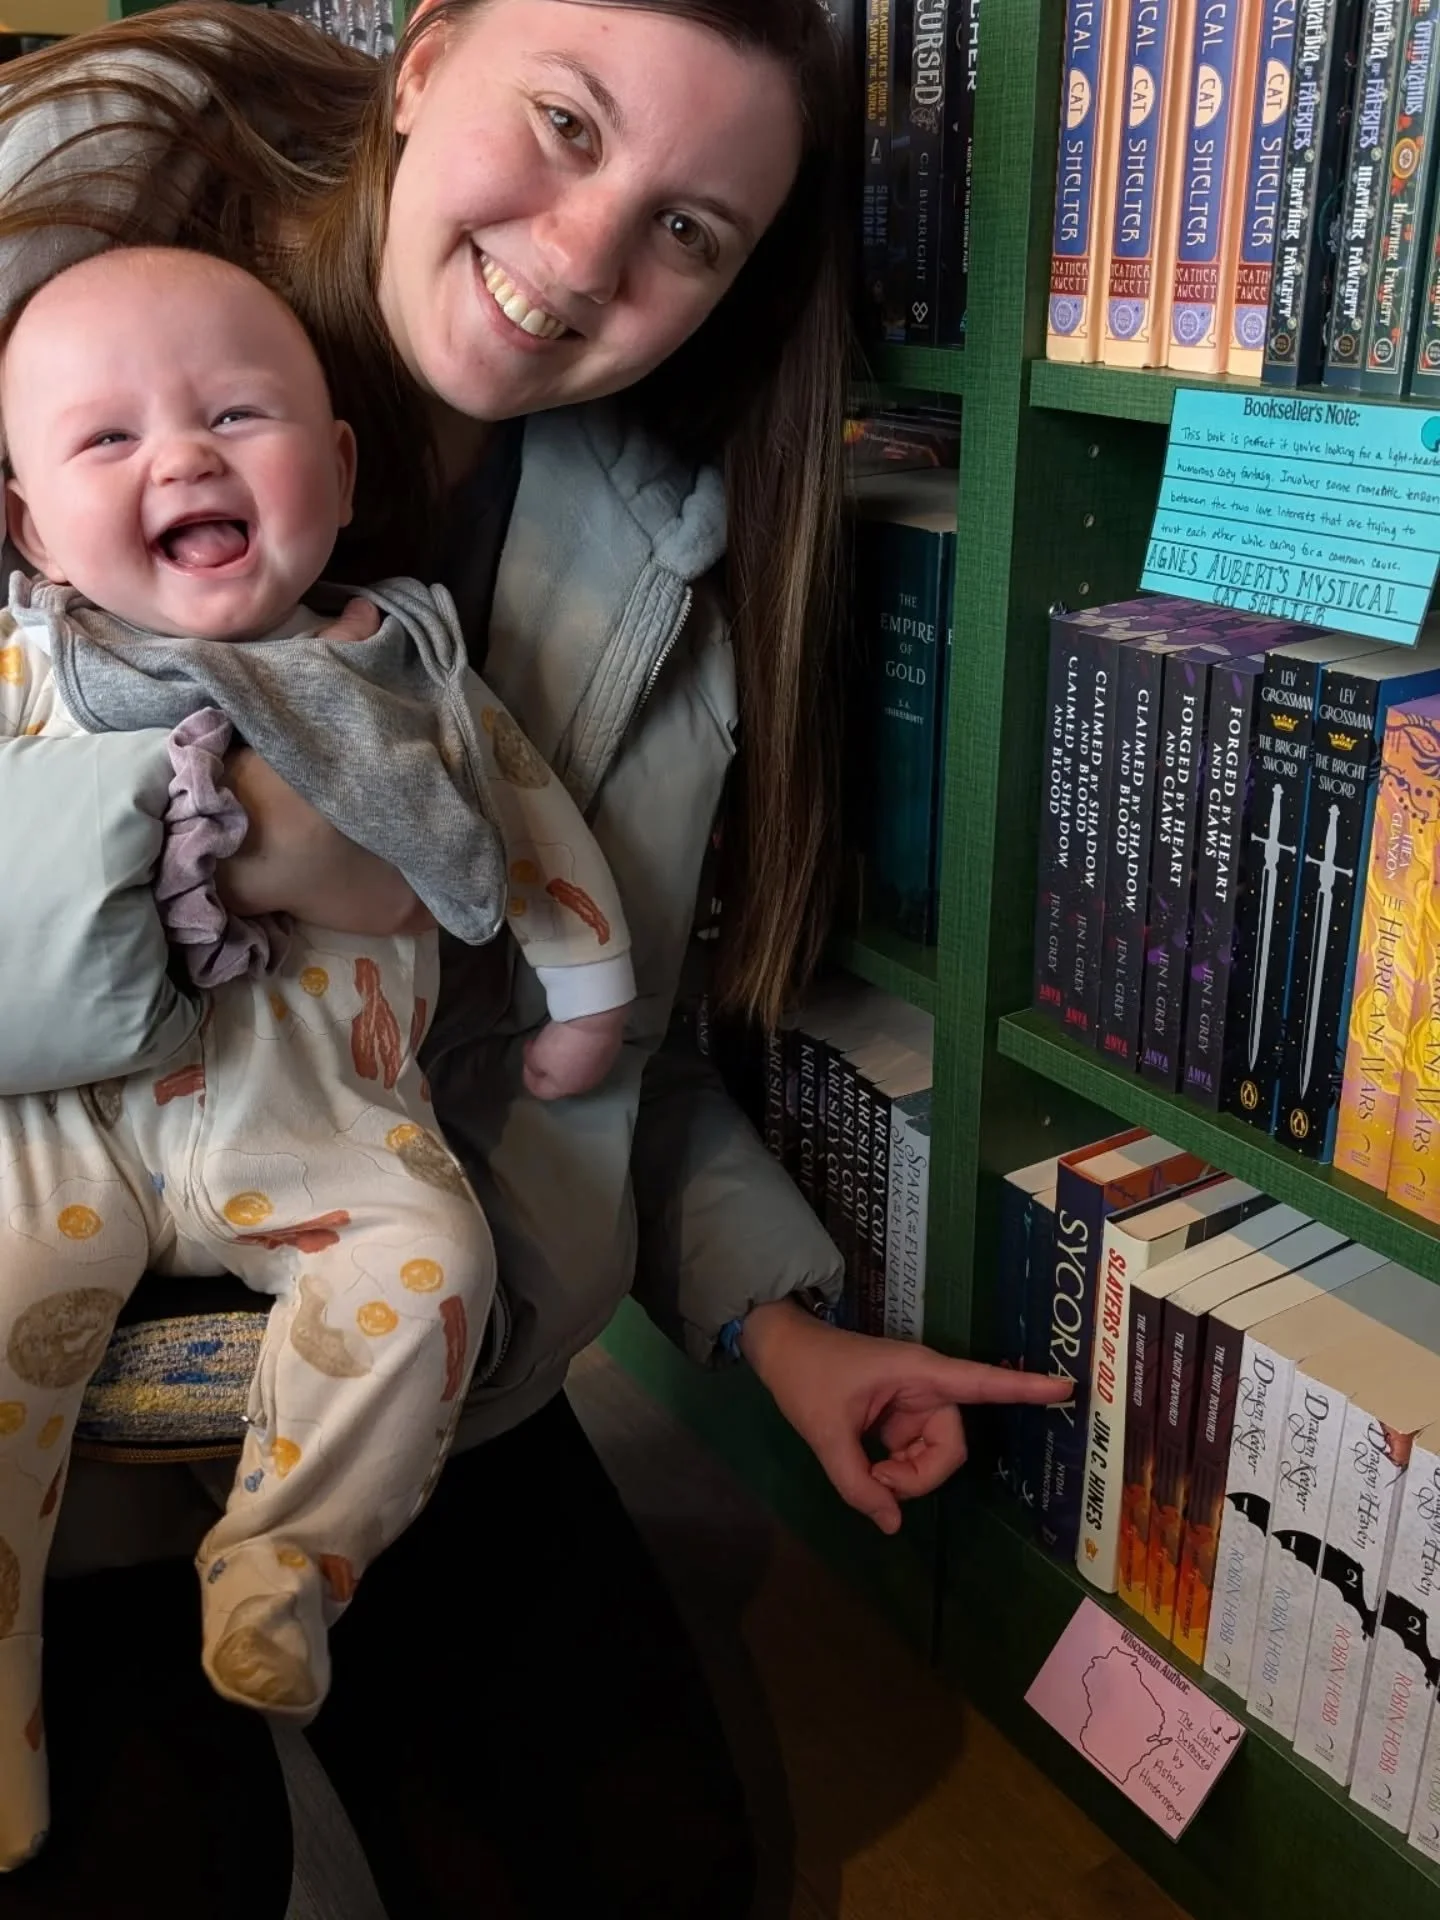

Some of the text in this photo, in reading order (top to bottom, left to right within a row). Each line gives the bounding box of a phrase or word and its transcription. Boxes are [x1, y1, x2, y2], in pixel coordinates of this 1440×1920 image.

[913, 0, 946, 105] CURSED
[1070, 82, 1085, 115] CAT
[1198, 78, 1216, 113] CAT
[1294, 82, 1317, 150] FAERIES
[1360, 78, 1385, 149] FAERIES
[1121, 78, 1148, 243] CAT SHELTER
[1251, 73, 1284, 247] CAT SHELTER
[1061, 139, 1083, 241] SHELTER
[1186, 139, 1214, 246] SHELTER
[1286, 167, 1306, 240] HEATHER
[1351, 166, 1374, 240] HEATHER
[1279, 246, 1298, 318] FAWCETT
[1344, 246, 1364, 318] FAWCETT
[1244, 398, 1360, 428] Bookseller's Note:
[1182, 427, 1200, 440] This
[1207, 429, 1224, 442] book
[1230, 433, 1238, 444] is
[1244, 436, 1275, 448] perfect
[1294, 440, 1320, 455] you're
[1325, 442, 1355, 464] looking
[1360, 446, 1372, 459] for
[1217, 467, 1236, 484] cozy
[1280, 469, 1320, 489] Involves
[1326, 480, 1350, 493] some
[1170, 491, 1206, 506] between
[1211, 492, 1227, 510] the
[1231, 498, 1250, 512] two
[1256, 504, 1272, 518] love
[1278, 505, 1316, 522] interests
[1320, 509, 1342, 526] that
[1366, 517, 1397, 541] trying
[1402, 524, 1416, 534] to
[1161, 524, 1182, 536] trust
[1186, 525, 1207, 538] each
[1212, 527, 1236, 542] other
[1241, 533, 1266, 548] while
[1269, 540, 1296, 560] caring
[1328, 551, 1365, 566] common
[900, 592, 918, 608] THE
[1147, 544, 1399, 616] AGNES AUBERT'S MYSTICAL
[1212, 585, 1327, 626] CAT SHELTER
[880, 612, 936, 644] EMPIRE
[900, 642, 913, 656] OF
[886, 660, 926, 686] GOLD
[1261, 687, 1314, 712] GROSSMAN
[1281, 670, 1298, 686] LEV
[1340, 688, 1356, 704] LEV
[1319, 704, 1374, 730] GROSSMAN
[1050, 704, 1064, 814] AND BLOOD
[1058, 656, 1078, 868] CLAIMED BY SHADOW
[1258, 734, 1308, 761] THE BRIGHT
[1263, 756, 1298, 777] SWORD
[1315, 752, 1367, 781] THE BRIGHT
[1076, 720, 1090, 833] AND BLOOD
[1084, 670, 1108, 888] CLAIMED BY SHADOW
[1116, 740, 1132, 856] AND BLOOD
[1125, 688, 1150, 913] CLAIMED BY SHADOW
[1160, 730, 1176, 844] AND CLAWS
[1170, 694, 1195, 888] FORGED BY HEART
[1205, 742, 1223, 858] AND CLAWS
[1318, 775, 1356, 798] SWORD
[1215, 706, 1243, 904] FORGED BY HEART
[1385, 813, 1402, 880] GUANZON
[1198, 966, 1215, 1055] JEN GREY
[1366, 915, 1402, 1057] HURRICANE
[1187, 1065, 1213, 1093] ANYA
[1360, 1056, 1386, 1122] WARS
[873, 1104, 889, 1194] KRESLEY
[905, 1144, 927, 1221] SPARK
[1133, 1313, 1146, 1407] THE LIGHT DEVOURED
[1086, 1248, 1126, 1531] SLAYERS OF OLD JIM C. HINES
[1206, 1344, 1226, 1443] THE LIGHT DEVOURED
[1280, 1388, 1330, 1514] Dragon Keeper
[1289, 1535, 1296, 1550] 1
[1346, 1568, 1361, 1588] 2
[1270, 1587, 1291, 1642] ROBIN
[1407, 1614, 1422, 1636] 2
[1120, 1630, 1162, 1672] Wisconsin
[1263, 1638, 1283, 1685] HOBB
[1330, 1623, 1352, 1678] ROBIN
[1178, 1708, 1193, 1728] The
[1322, 1674, 1346, 1727] HOBB
[1390, 1671, 1413, 1726] ROBIN
[1172, 1748, 1184, 1770] by
[1177, 1728, 1213, 1770] Devoured
[1378, 1724, 1404, 1775] HOBB
[1153, 1758, 1186, 1796] Ashley
